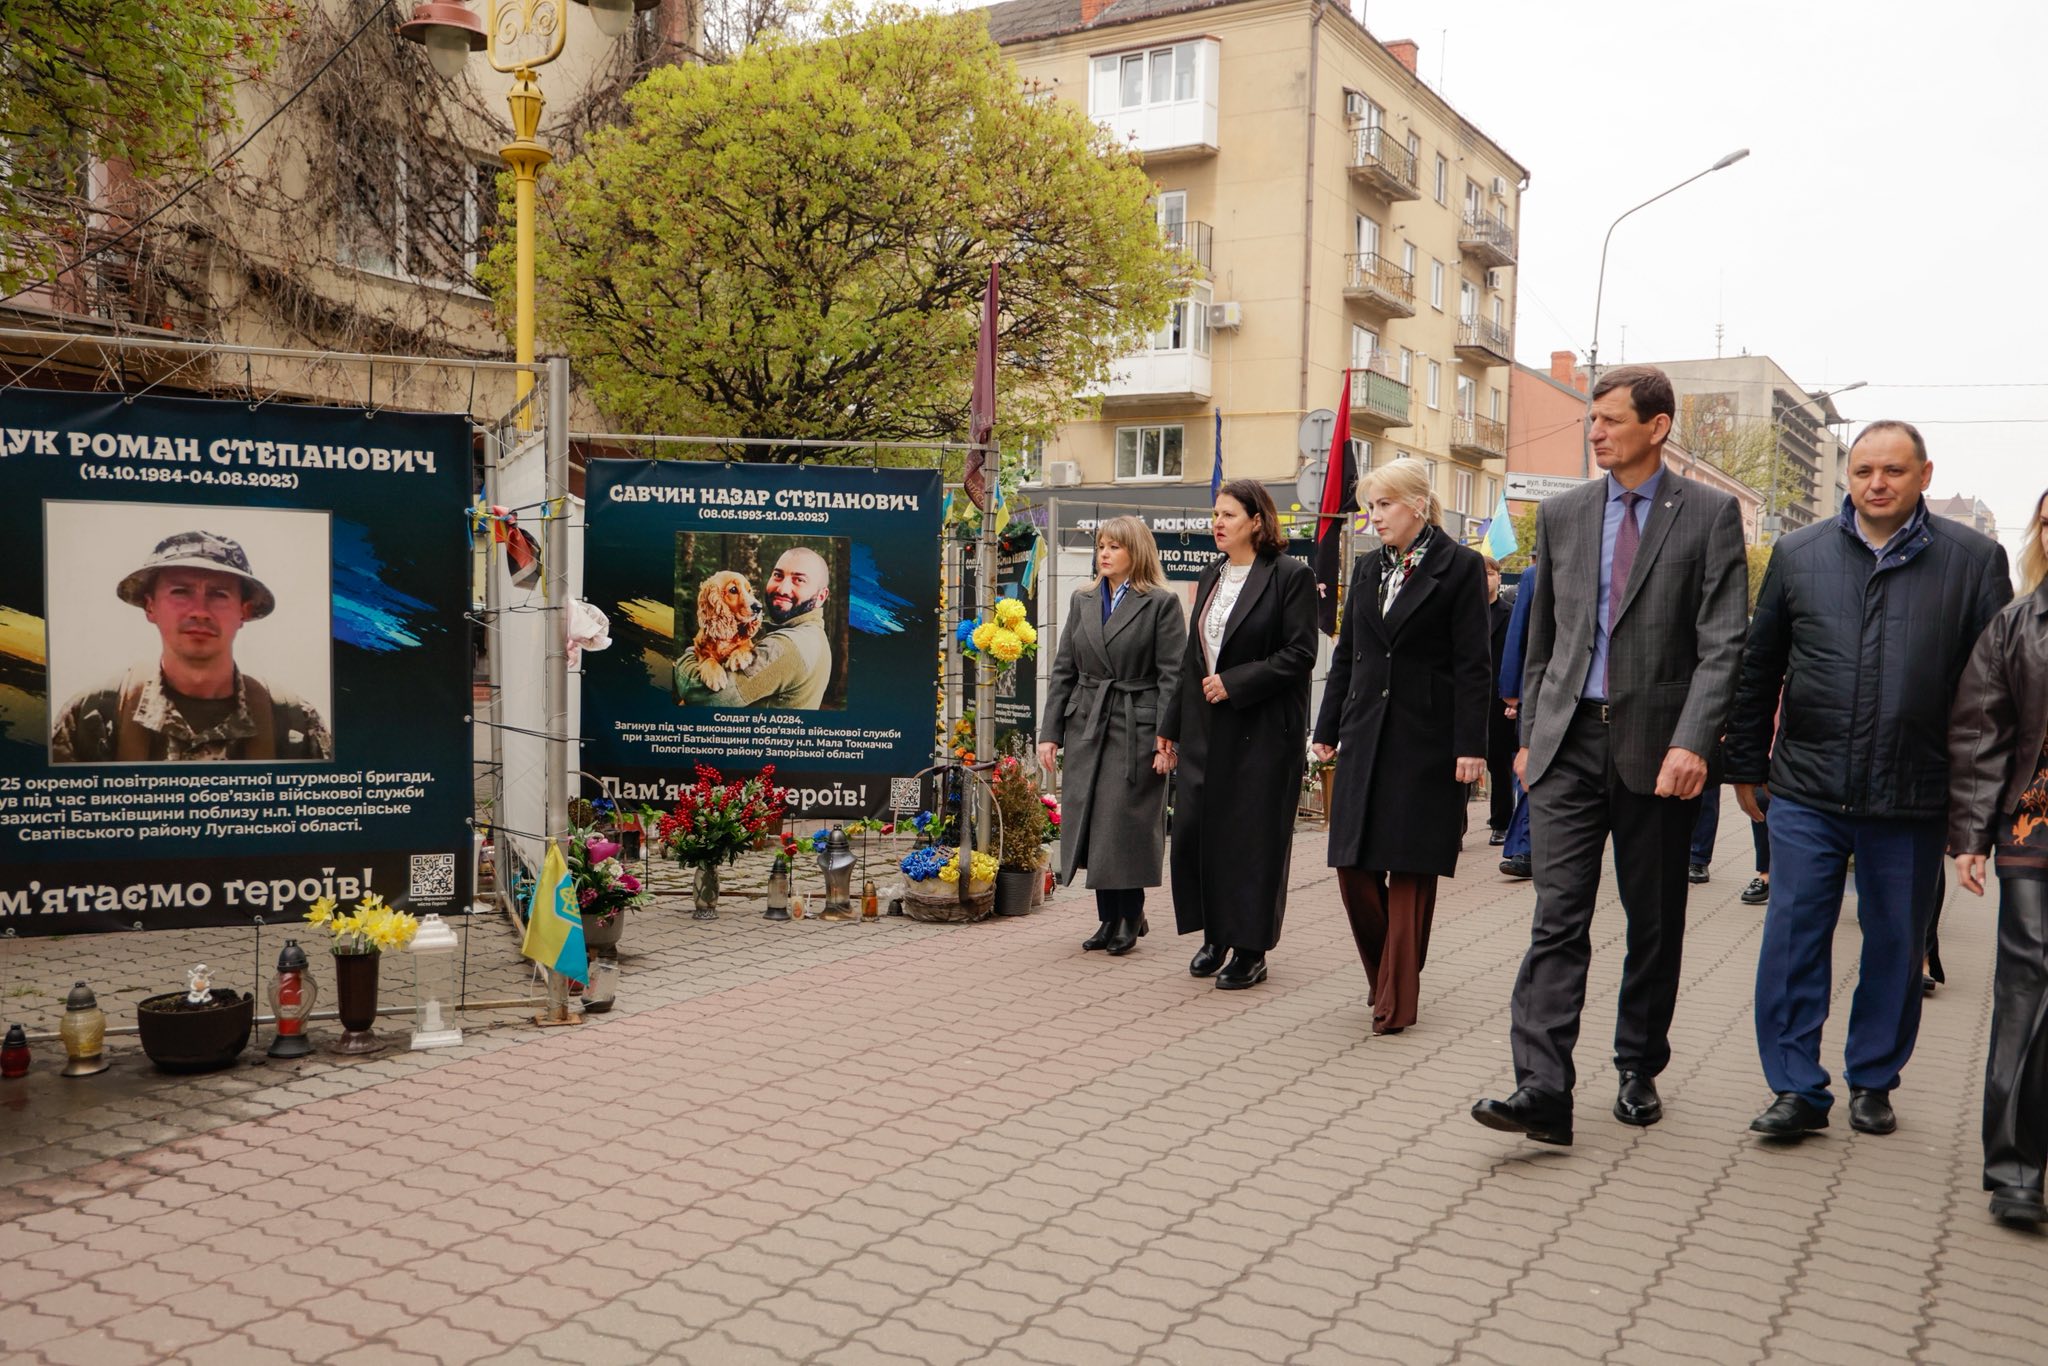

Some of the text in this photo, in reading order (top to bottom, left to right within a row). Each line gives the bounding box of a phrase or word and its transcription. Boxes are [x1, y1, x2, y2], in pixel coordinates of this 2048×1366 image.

[67, 432, 202, 462] РОМАН
[208, 438, 437, 474] СТЕПАНОВИЧ
[80, 463, 299, 489] (14.10.1984-04.08.2023)
[609, 484, 920, 511] САВЧИН НАЗАР СТЕПАНОВИЧ
[698, 507, 829, 523] (08.05.1993-21.09.2023)
[1153, 517, 1213, 531] маркет
[713, 712, 804, 724] Солдат в/ч А0284.
[614, 721, 901, 739] Загинув під час виконання обов'язків військової служби
[622, 733, 893, 749] при захисті Батьківщини поблизу н.п. Мала Токмачка
[651, 744, 864, 760] Пологівського району Запорізької області
[1, 770, 435, 791] 25 окремої повітрянодесантної штурмової бригади.
[23, 793, 52, 808] під
[56, 795, 86, 806] час
[91, 793, 185, 805] виконання
[189, 789, 275, 803] обов’язків
[279, 787, 363, 801] військової
[366, 785, 424, 802] служби
[1, 802, 412, 825] захисті Батьківщини поблизу н.п. Новоселівське
[18, 818, 363, 841] Сватівського району Луганської області.
[223, 867, 373, 911] героїв!
